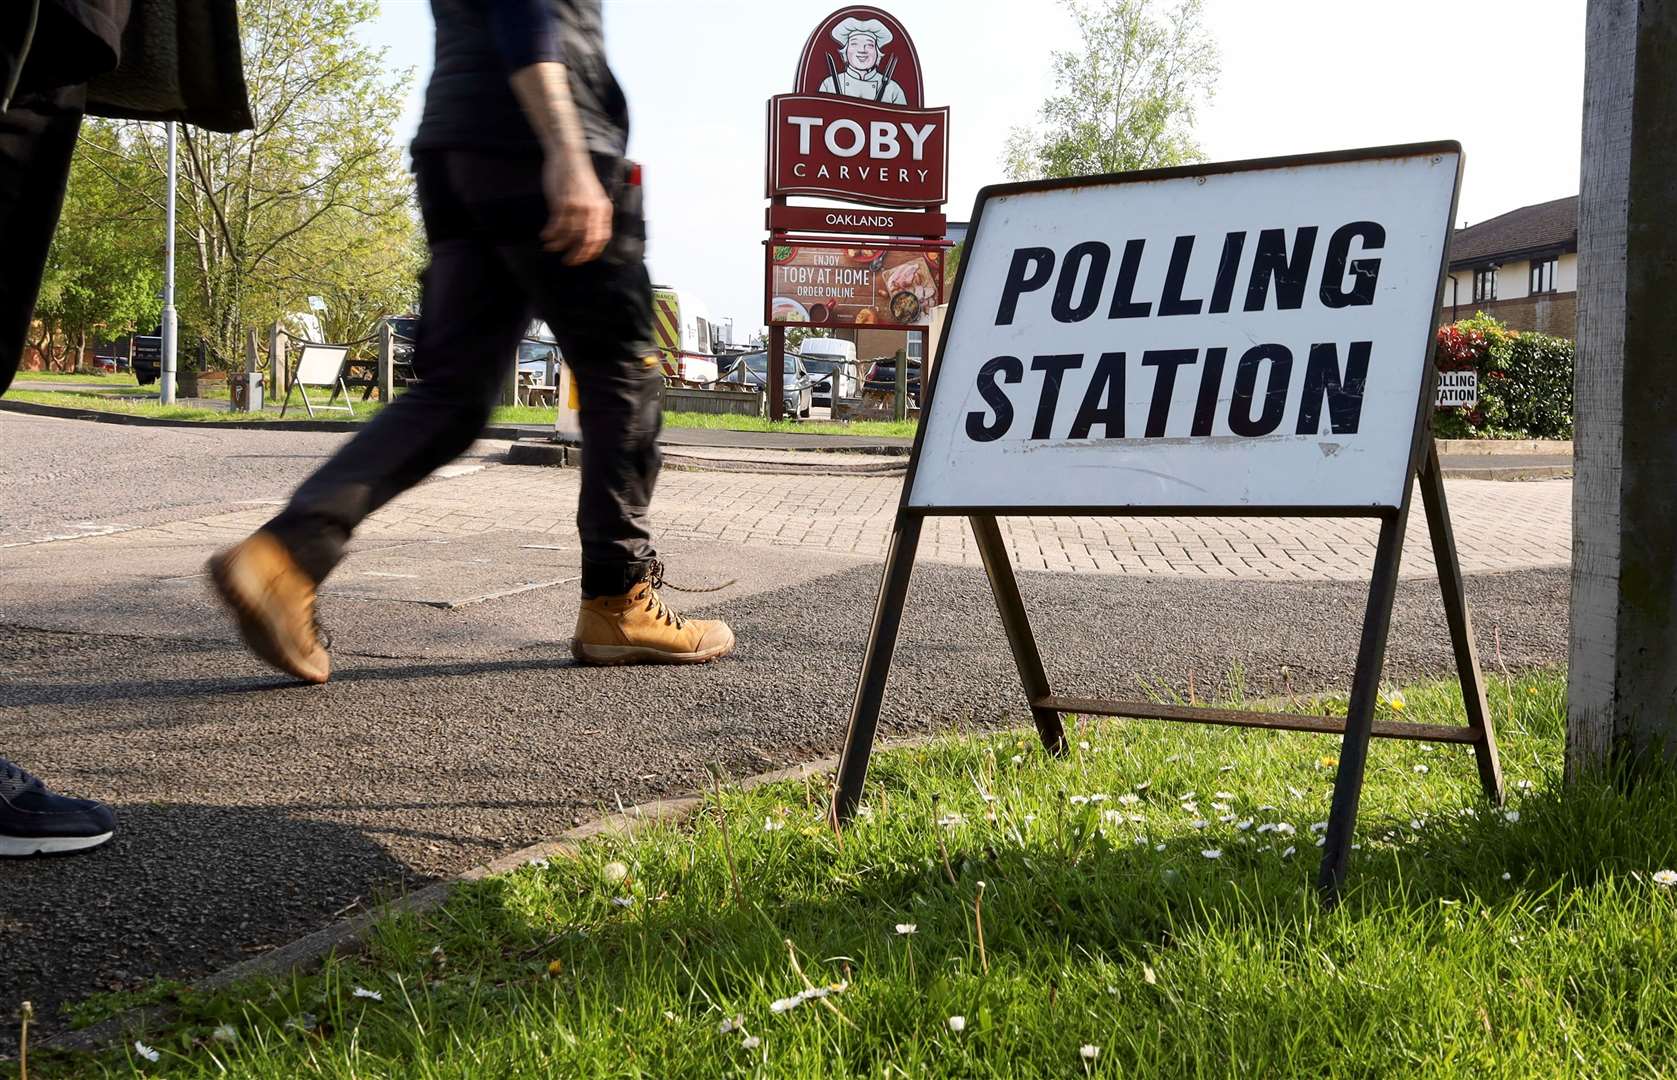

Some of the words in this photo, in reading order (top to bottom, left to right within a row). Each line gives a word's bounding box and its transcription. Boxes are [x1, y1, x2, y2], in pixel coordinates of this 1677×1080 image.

[787, 115, 937, 161] TOBY
[793, 163, 928, 184] CARVERY
[825, 213, 894, 228] OAKLANDS
[813, 255, 840, 266] ENJOY
[782, 266, 815, 283] TOBY
[817, 269, 832, 284] AT
[835, 270, 870, 286] HOME
[994, 220, 1386, 326] POLLING
[797, 286, 824, 297] ORDER
[825, 287, 855, 298] ONLINE
[1437, 375, 1475, 387] OLLING
[965, 340, 1373, 443] STATION
[1436, 389, 1475, 401] TATION
